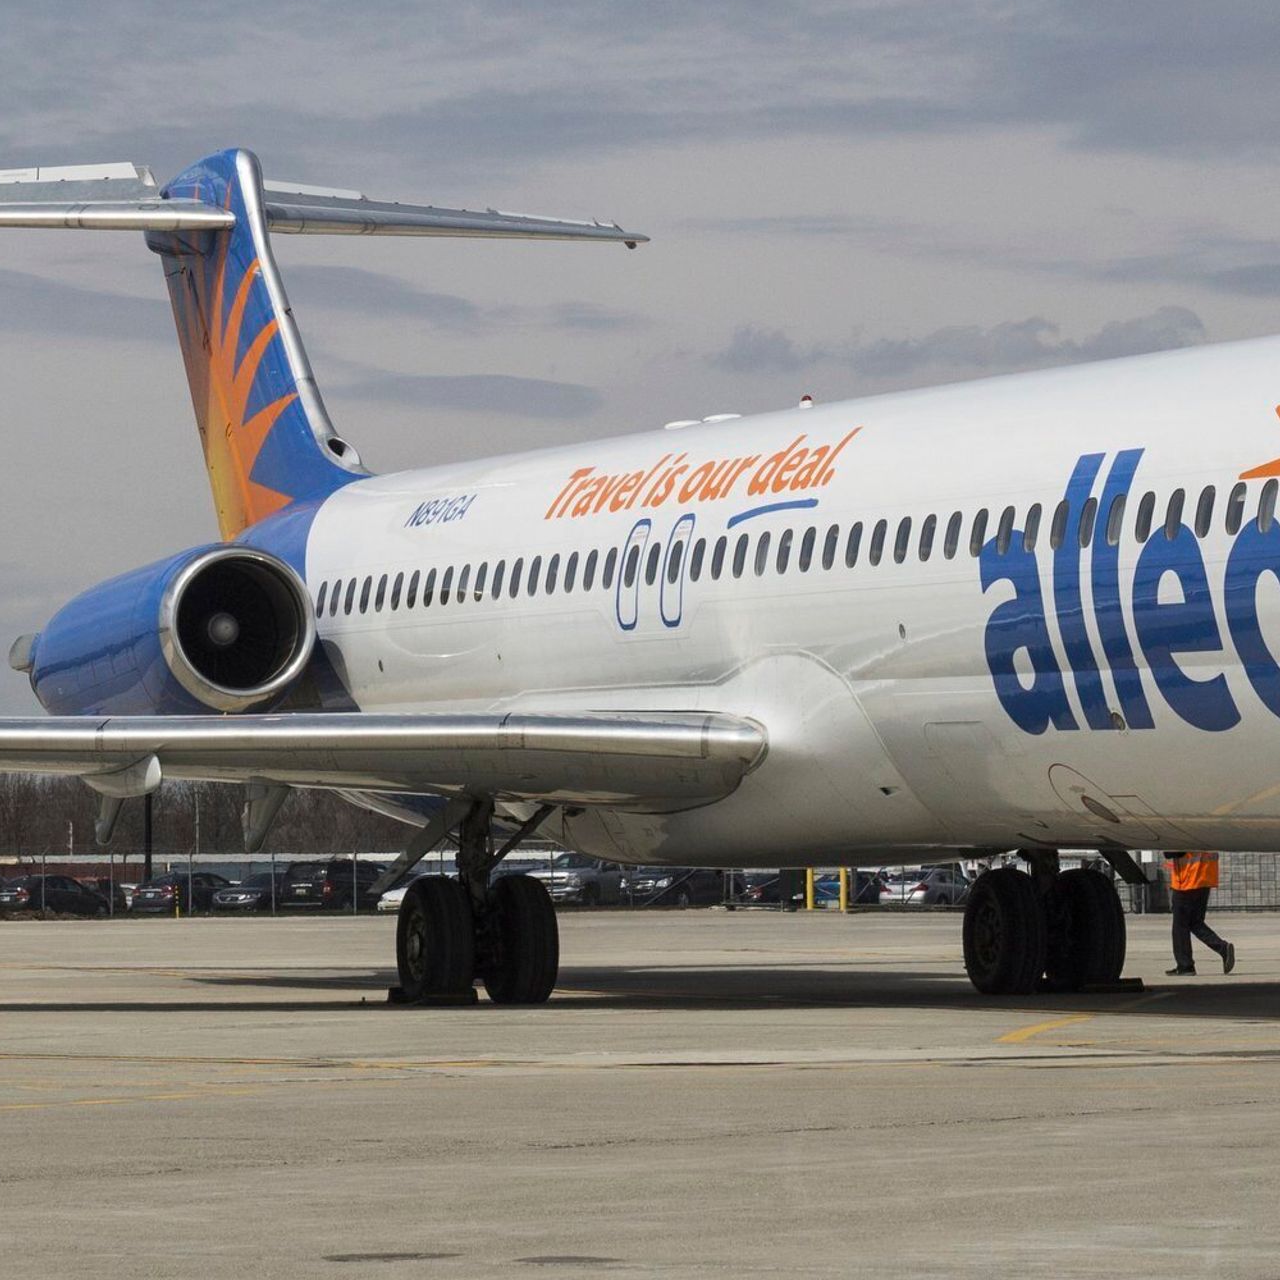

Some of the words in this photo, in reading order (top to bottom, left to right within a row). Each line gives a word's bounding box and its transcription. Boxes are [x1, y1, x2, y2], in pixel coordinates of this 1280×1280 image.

[544, 452, 674, 520] Travel
[641, 452, 689, 507] is
[678, 454, 762, 504] our
[747, 426, 863, 497] deal.
[403, 494, 478, 528] N891GA
